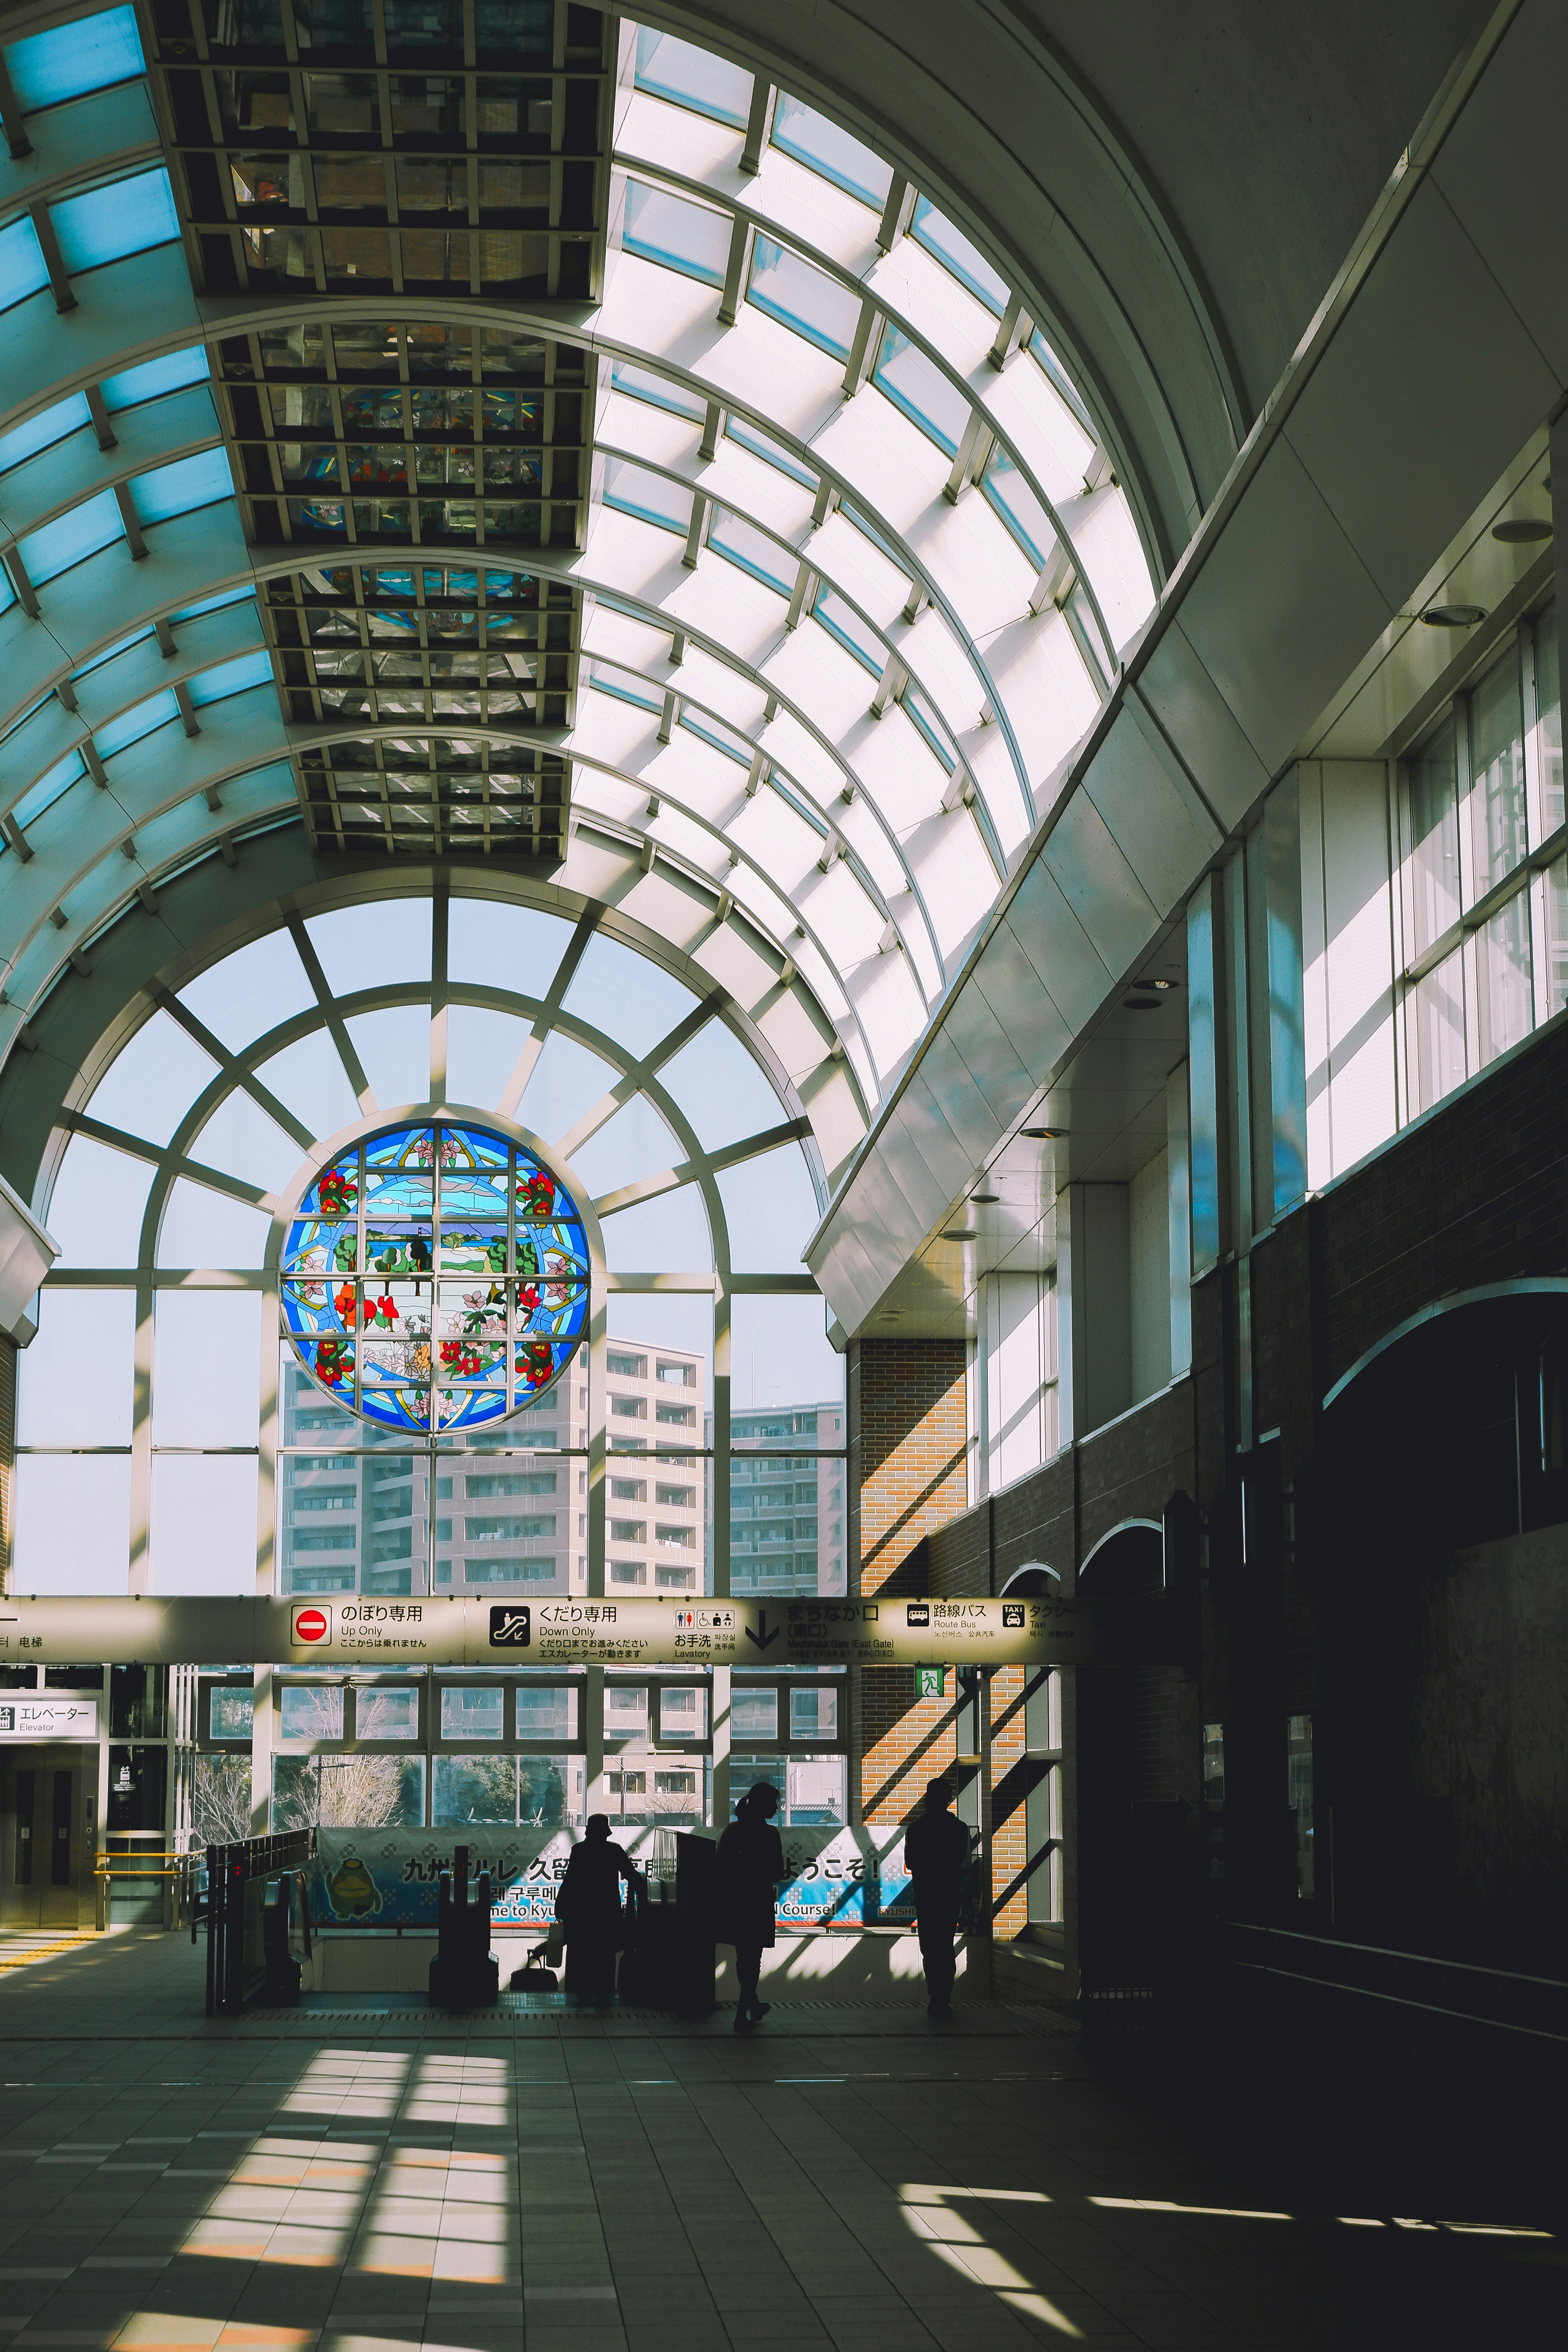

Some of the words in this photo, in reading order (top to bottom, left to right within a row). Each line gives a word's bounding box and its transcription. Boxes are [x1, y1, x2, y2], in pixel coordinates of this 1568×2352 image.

[342, 1605, 422, 1622] のぼり専用
[540, 1606, 617, 1623] くだり専用
[788, 1604, 879, 1622] まちなか口
[934, 1604, 987, 1617] 路線バス
[1029, 1605, 1079, 1617] タクシー
[342, 1626, 355, 1637] Up
[359, 1625, 382, 1637] Only
[540, 1627, 568, 1636] Down
[571, 1627, 595, 1638] Only
[20, 1636, 42, 1647] 电梯
[341, 1639, 426, 1647] ここからは乗れません
[539, 1639, 648, 1648] くだり口までお進みください
[674, 1634, 711, 1648] お手洗
[788, 1639, 829, 1648] Machinaka
[831, 1639, 849, 1648] Gate
[851, 1639, 871, 1648] (East
[873, 1639, 894, 1648] Gate)
[539, 1649, 641, 1658] エスカレーターが動きます
[675, 1650, 710, 1659] Lavatory
[20, 1707, 89, 1720] エレベーター
[512, 1905, 526, 1916] to
[783, 1903, 835, 1915] Course!
